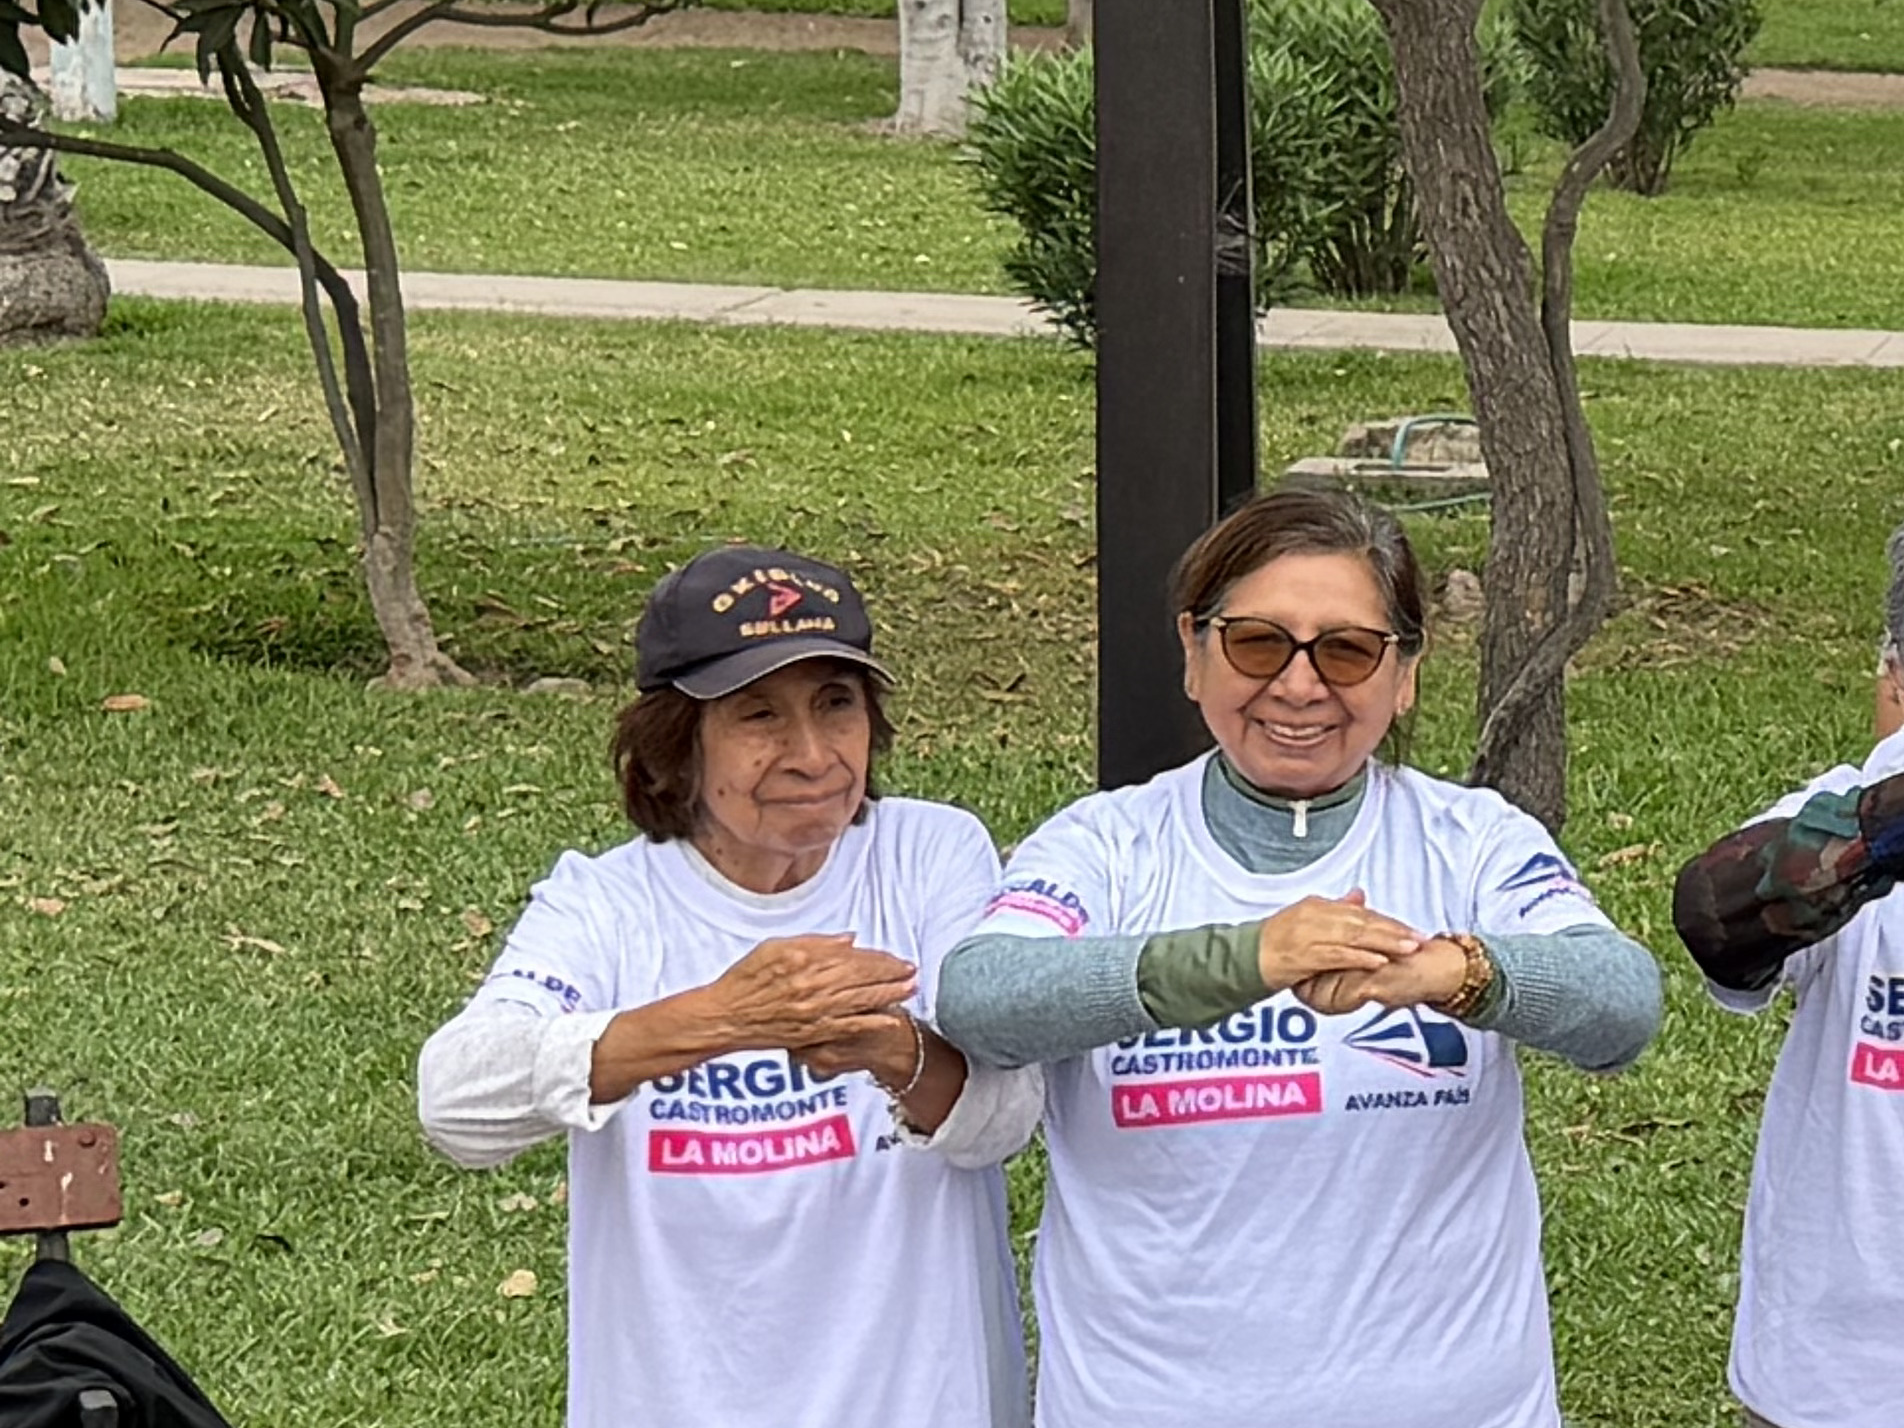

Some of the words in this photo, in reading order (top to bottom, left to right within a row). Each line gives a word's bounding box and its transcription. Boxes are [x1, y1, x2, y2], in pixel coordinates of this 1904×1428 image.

[1111, 1046, 1321, 1076] CASTROMONTE
[1864, 1051, 1901, 1083] LA
[649, 1085, 848, 1126] CASTROMONTE
[1121, 1093, 1161, 1121] LA
[1168, 1080, 1308, 1116] MOLINA
[1344, 1090, 1429, 1111] AVANZA
[661, 1137, 704, 1166] LA
[711, 1123, 842, 1167] MOLINA
